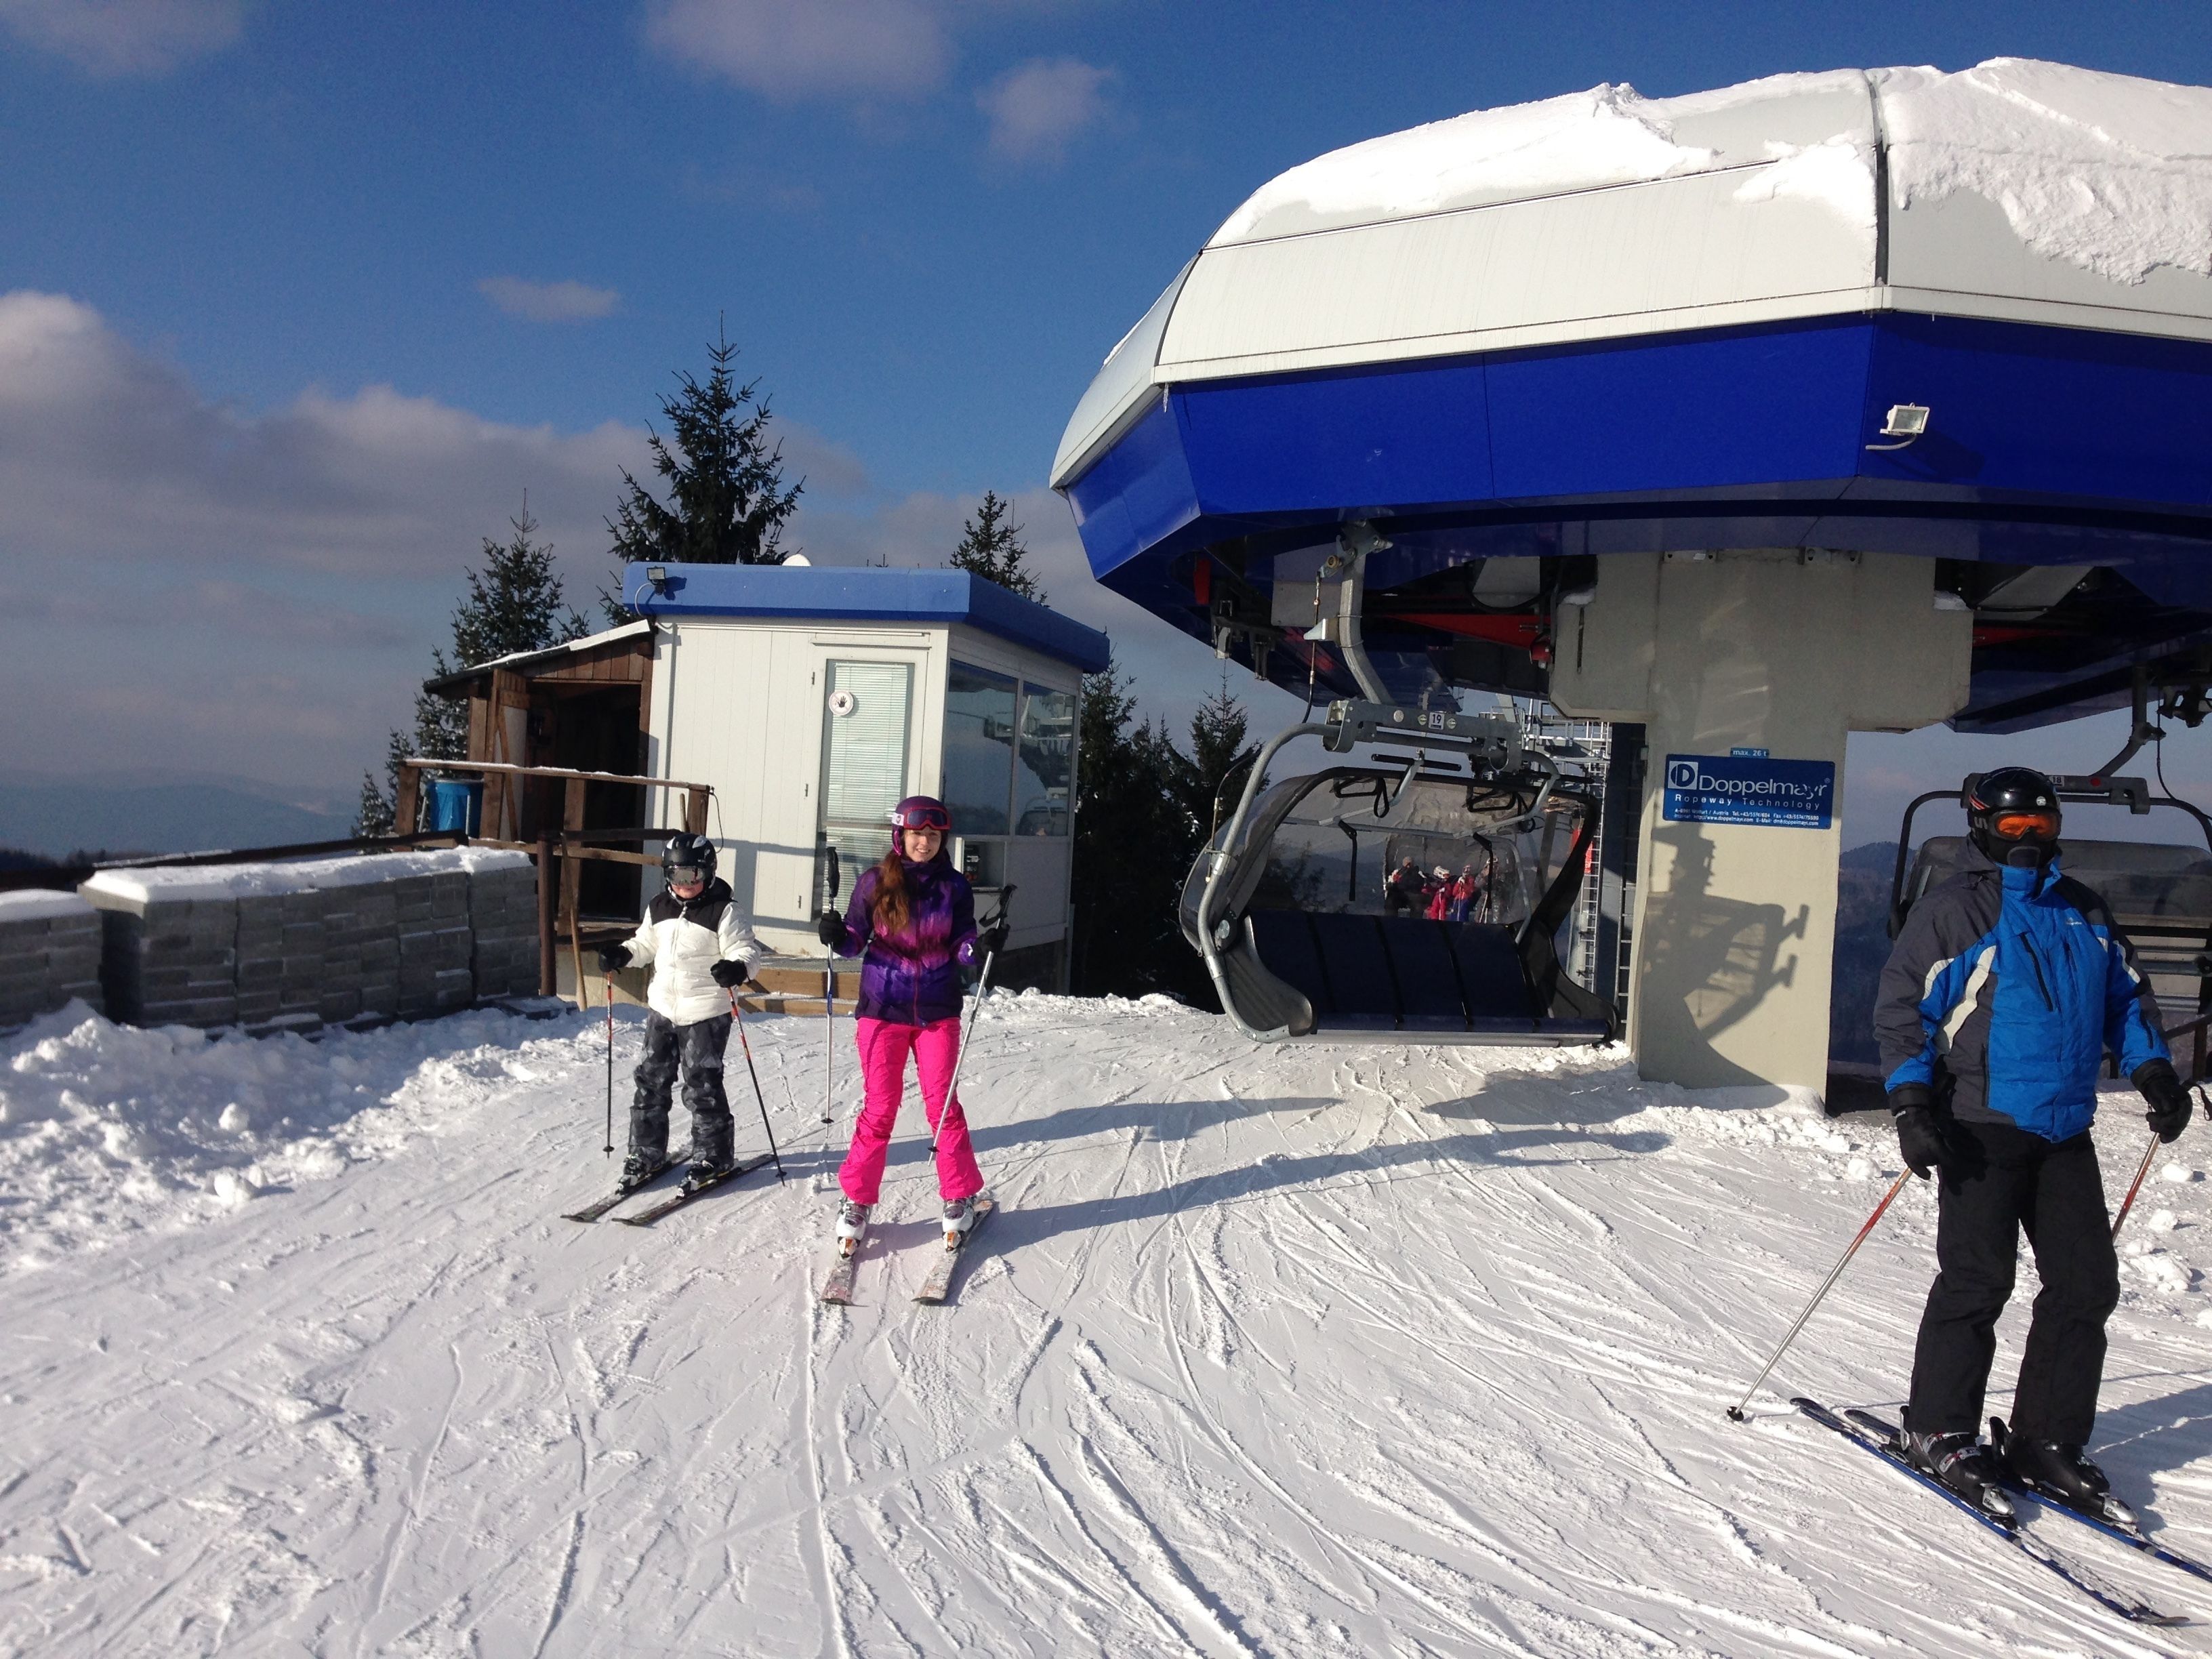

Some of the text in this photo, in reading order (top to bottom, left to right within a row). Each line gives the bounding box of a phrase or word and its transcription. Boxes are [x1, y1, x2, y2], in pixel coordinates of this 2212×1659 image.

[1433, 714, 1441, 724] 19
[1699, 775, 1827, 799] Doppelmayr
[1675, 794, 1820, 811] Ropeway Technology
